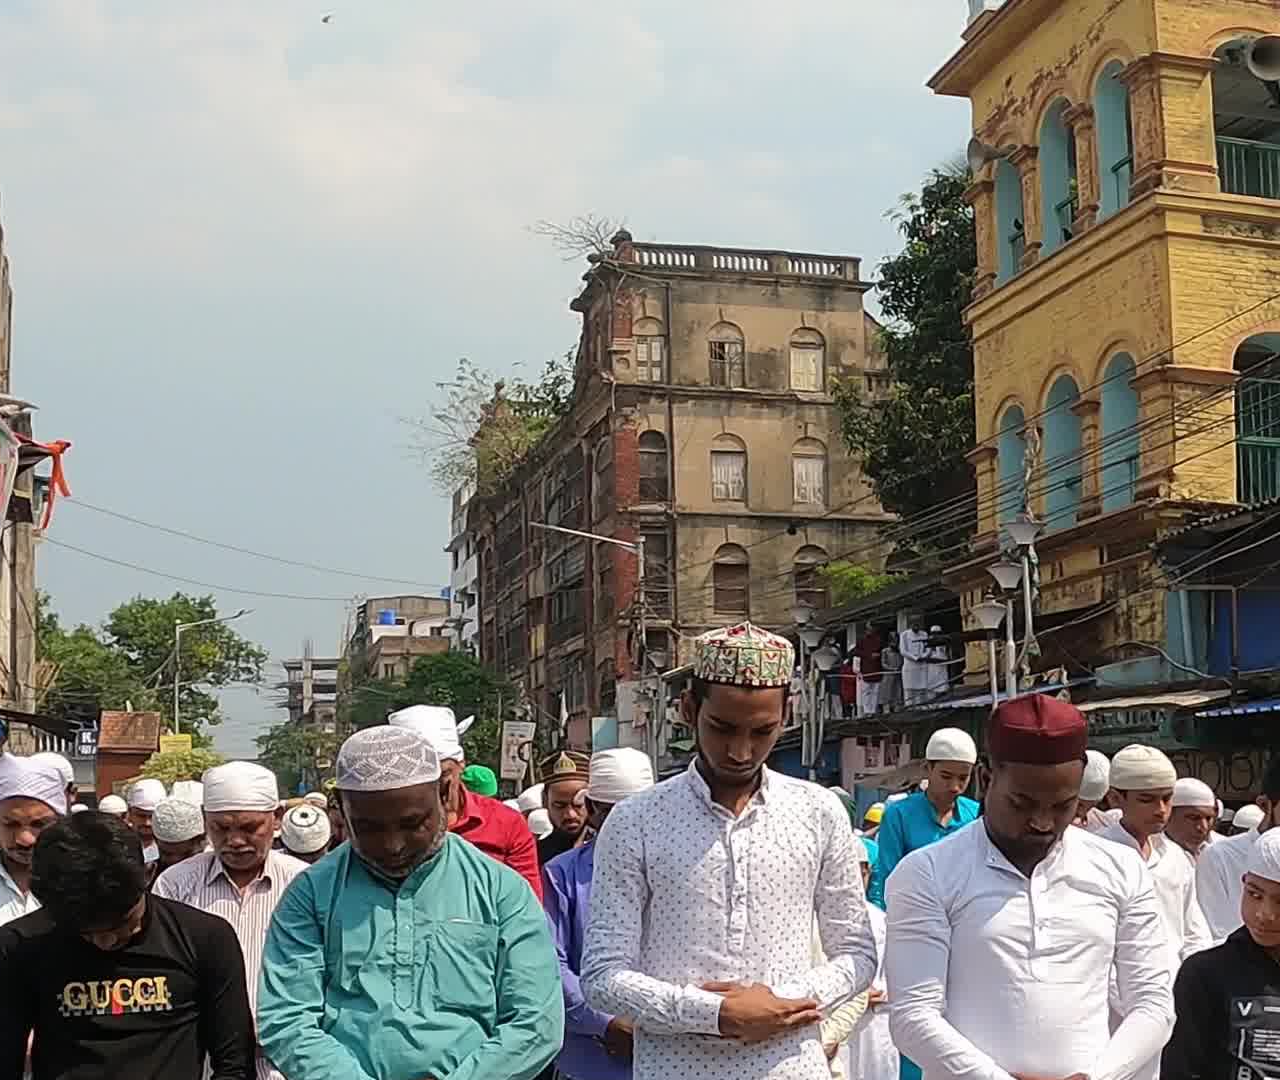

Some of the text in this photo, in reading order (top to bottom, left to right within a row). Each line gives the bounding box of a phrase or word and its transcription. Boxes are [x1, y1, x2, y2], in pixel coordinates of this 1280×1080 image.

[63, 976, 167, 1010] GUCCI
[1237, 1002, 1252, 1016] V
[1237, 1066, 1252, 1080] B
